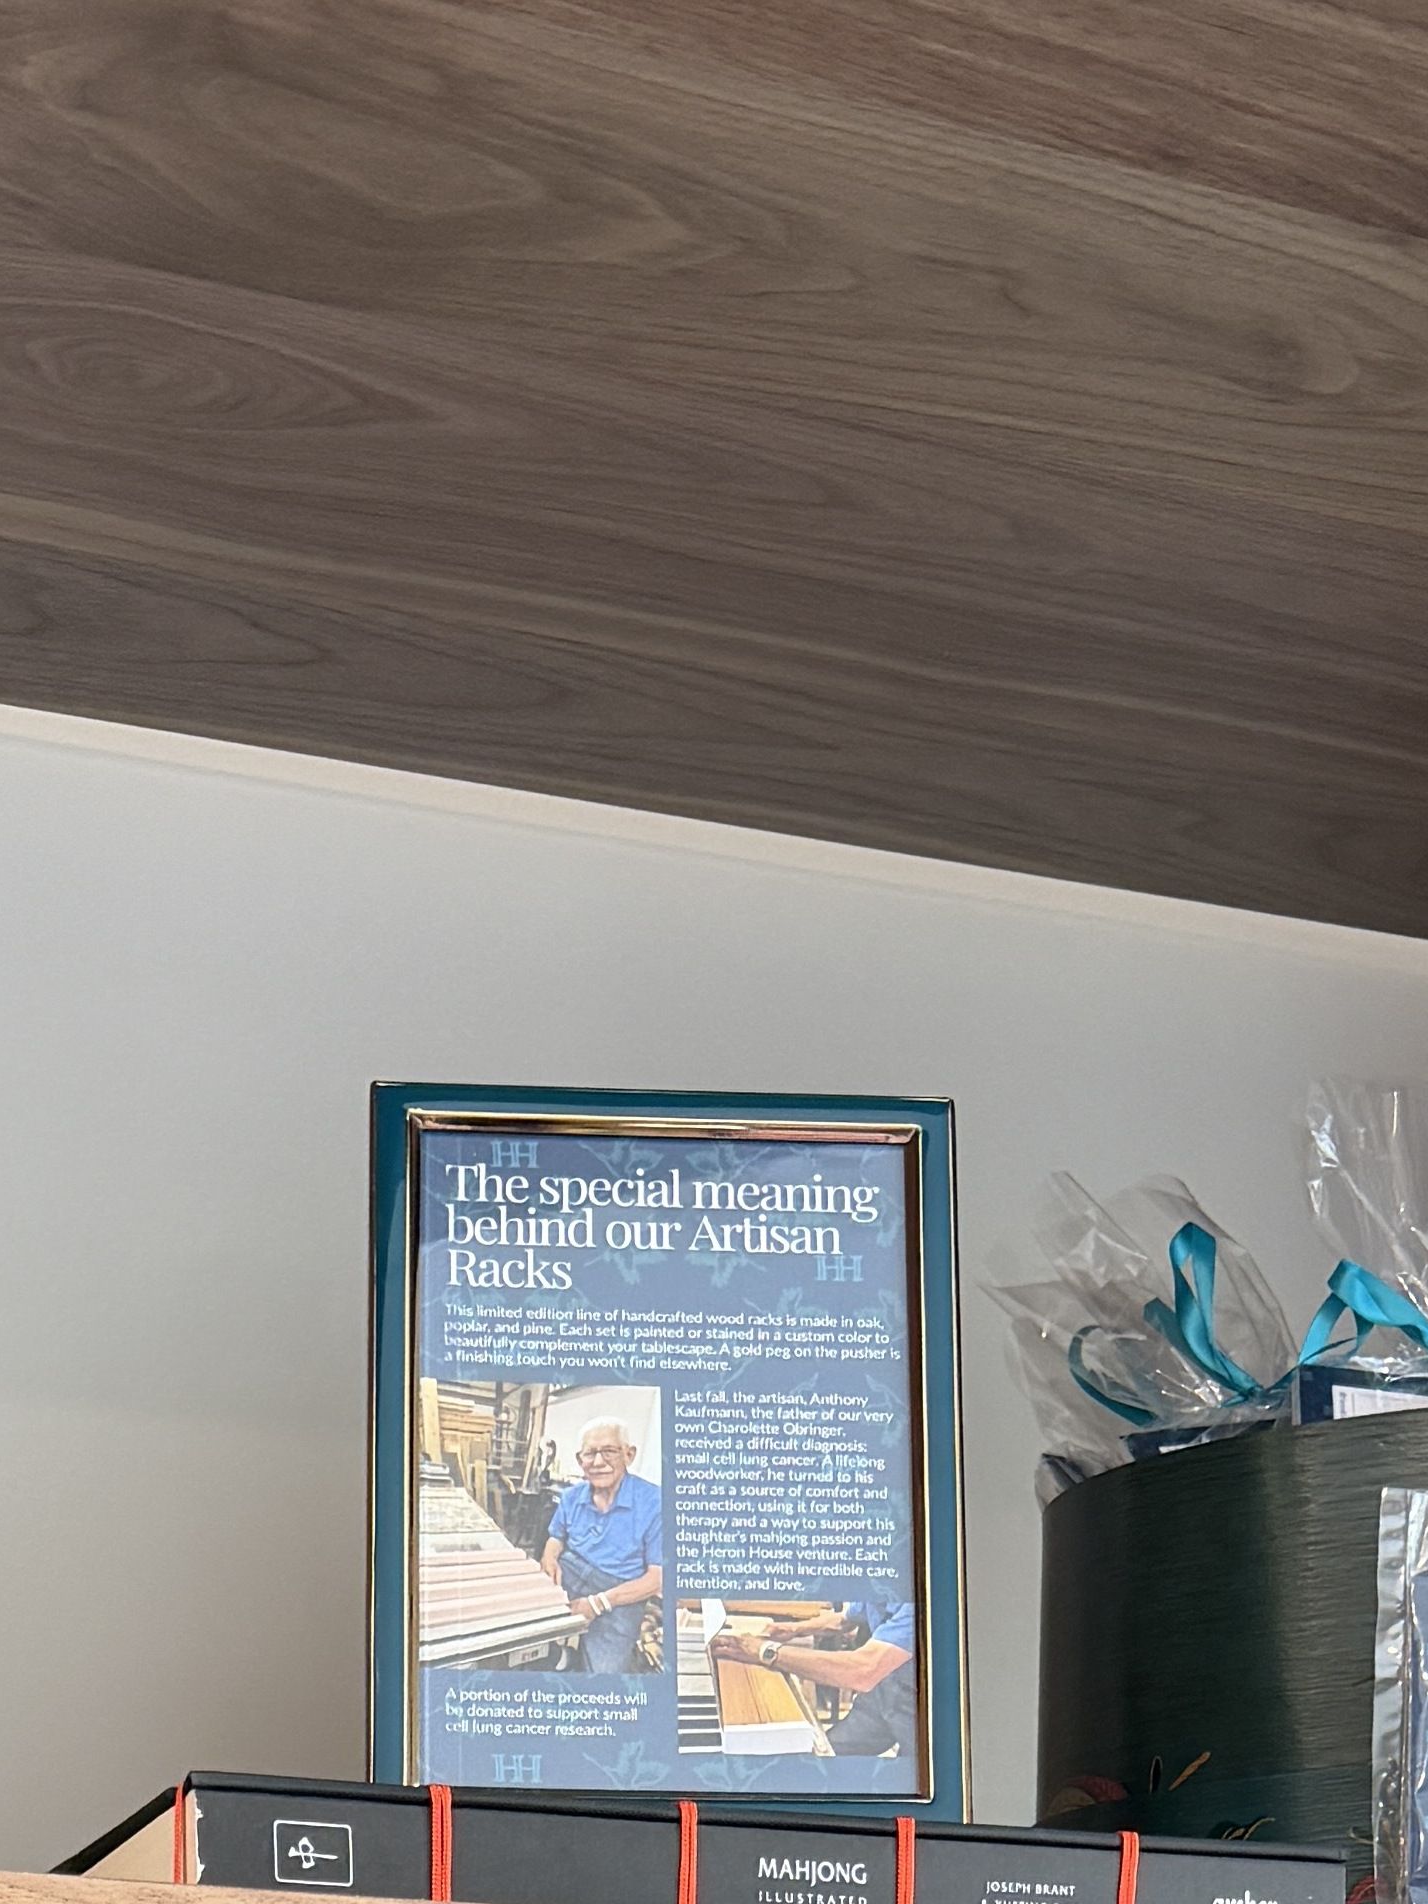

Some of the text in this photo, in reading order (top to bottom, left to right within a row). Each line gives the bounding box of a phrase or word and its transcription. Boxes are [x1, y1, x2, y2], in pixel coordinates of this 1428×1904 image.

[445, 1163, 880, 1222] The special meaning
[445, 1204, 843, 1254] behind our Artisan
[447, 1249, 573, 1289] Racks
[446, 1303, 473, 1316] This
[476, 1304, 522, 1318] limited
[526, 1306, 573, 1319] edition
[576, 1307, 600, 1320] line
[621, 1308, 702, 1323] handcrafted
[707, 1311, 744, 1325] wood
[748, 1312, 782, 1326] racks
[800, 1314, 837, 1327] made
[494, 1320, 519, 1334] and
[559, 1322, 592, 1336] Each
[595, 1325, 615, 1337] set
[634, 1325, 684, 1342] painted
[706, 1327, 753, 1341] stained
[785, 1331, 834, 1343] custom
[838, 1331, 872, 1344] color
[444, 1334, 516, 1351] beautifully
[519, 1336, 604, 1354] complement
[607, 1342, 637, 1355] your
[719, 1342, 730, 1355] A
[733, 1342, 762, 1359] gold
[766, 1346, 791, 1359] peg
[815, 1345, 837, 1358] the
[841, 1345, 886, 1362] pusher
[456, 1349, 514, 1367] finishing
[518, 1351, 555, 1365] touch
[559, 1356, 584, 1369] you
[630, 1355, 655, 1369] find
[674, 1389, 701, 1402] Last
[733, 1391, 755, 1404] the
[810, 1393, 868, 1410] Anthony
[751, 1407, 773, 1419] the
[777, 1407, 817, 1420] father
[838, 1412, 861, 1421] our
[864, 1412, 894, 1425] very
[674, 1423, 704, 1433] own
[675, 1436, 732, 1450] received
[747, 1438, 798, 1451] difficult
[675, 1451, 709, 1464] small
[713, 1452, 735, 1465] cell
[739, 1453, 768, 1469] lung
[835, 1455, 885, 1471] lifelong
[789, 1469, 833, 1482] turned
[855, 1470, 874, 1483] his
[675, 1482, 888, 1500] craft source comfort and
[758, 1500, 793, 1516] using
[810, 1501, 830, 1514] for
[833, 1501, 864, 1514] both
[676, 1513, 895, 1533] therapy and way support his
[676, 1529, 891, 1548] daughter's mahjong passion and
[676, 1544, 699, 1557] the
[702, 1545, 745, 1558] Heron
[749, 1546, 793, 1560] House
[855, 1549, 888, 1562] Each
[677, 1560, 705, 1573] rack
[722, 1561, 760, 1575] made
[764, 1562, 793, 1575] with
[798, 1563, 863, 1577] incredible
[745, 1577, 769, 1590] and
[445, 1688, 647, 1708] A portion the proceeds will
[467, 1704, 637, 1723] donated support small
[445, 1719, 468, 1732] cell
[472, 1720, 502, 1736] lung
[506, 1724, 552, 1735] cancer
[757, 1857, 868, 1887] MAHJONG
[986, 1881, 1076, 1896] JOSEPH BRANT
